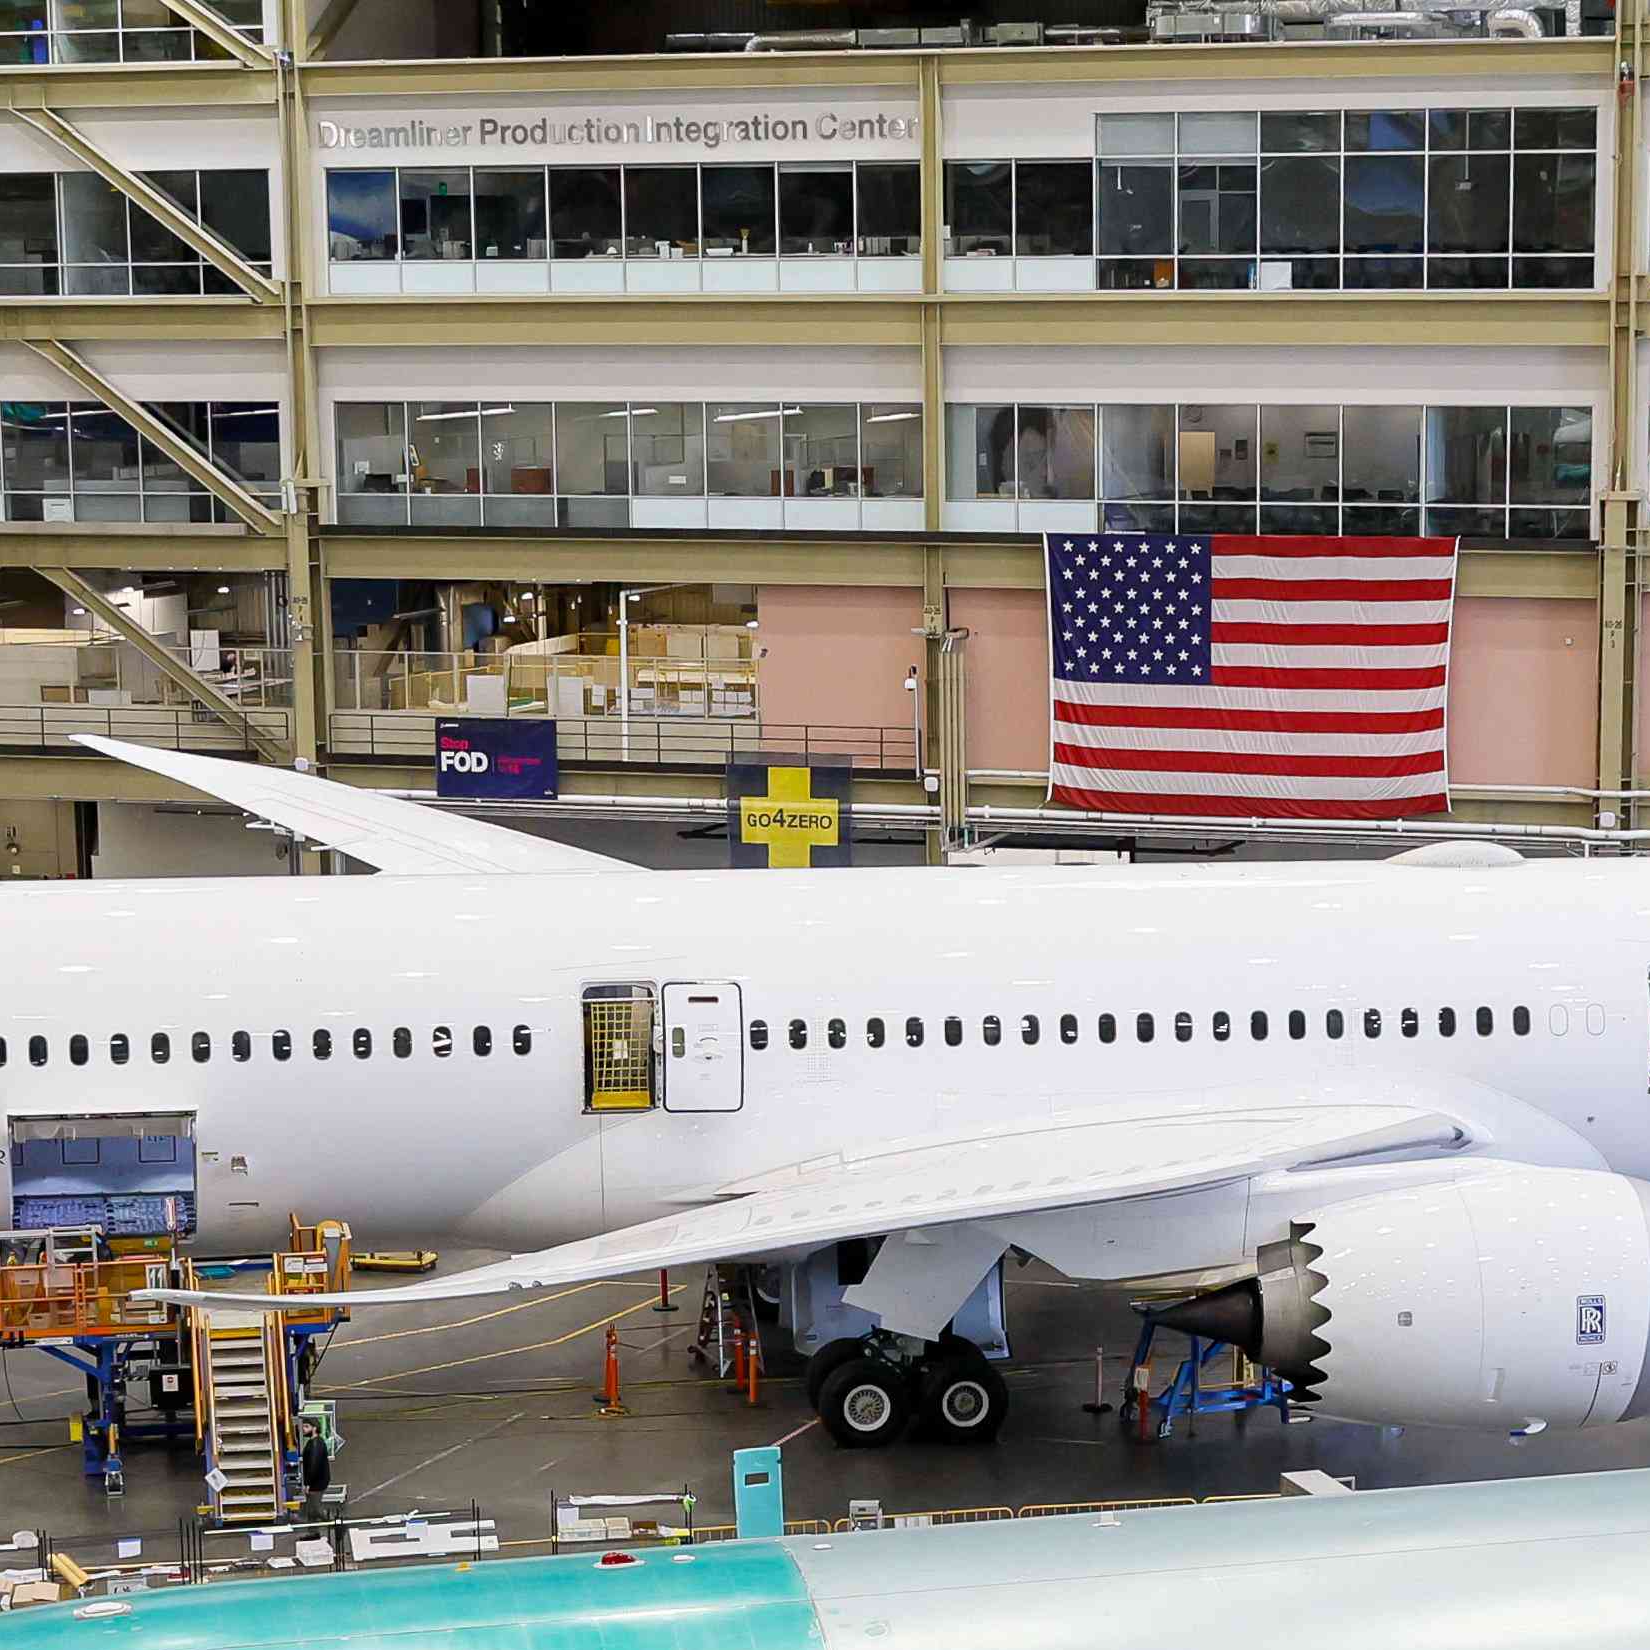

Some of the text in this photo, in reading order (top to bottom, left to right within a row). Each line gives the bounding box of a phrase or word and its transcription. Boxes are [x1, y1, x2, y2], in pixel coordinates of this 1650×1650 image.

[318, 112, 918, 149] Dreamliner Production Integration Center
[441, 751, 488, 772] FOD
[747, 808, 832, 829] GO4ZERO
